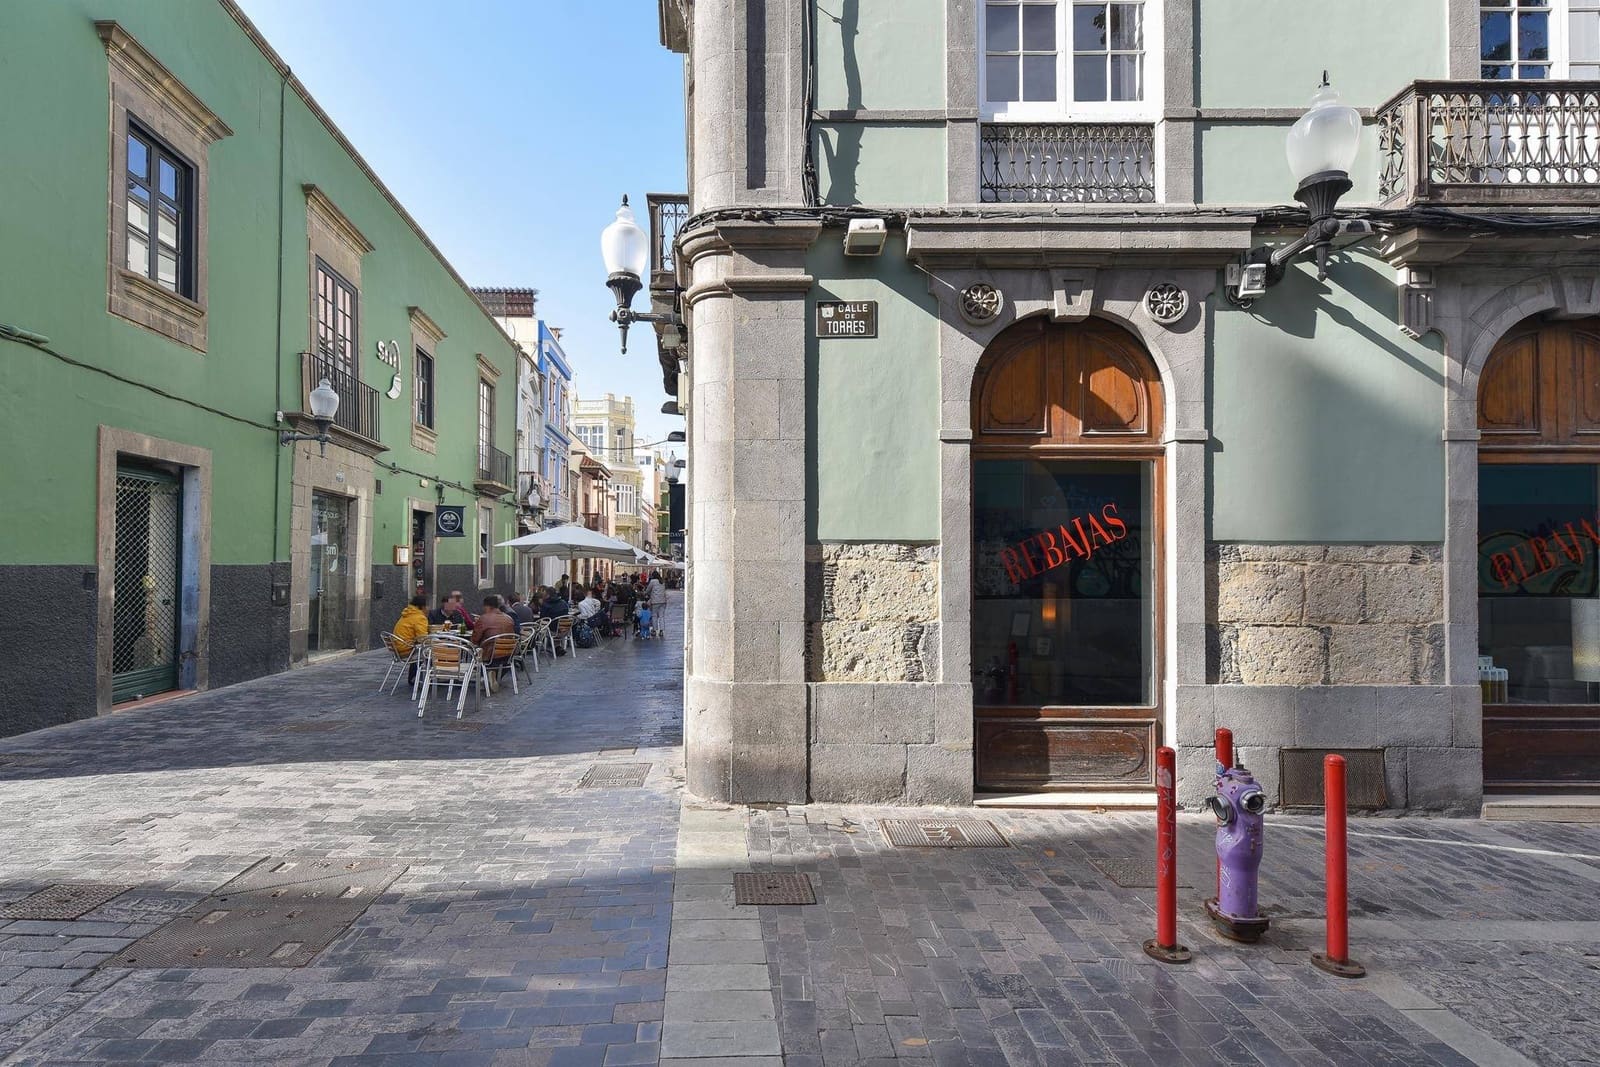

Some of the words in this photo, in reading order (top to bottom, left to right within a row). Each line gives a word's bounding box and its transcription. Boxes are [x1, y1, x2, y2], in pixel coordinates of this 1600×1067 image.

[838, 303, 868, 313] CALLE
[826, 320, 866, 334] TORRES
[1000, 502, 1128, 585] REBAJAS
